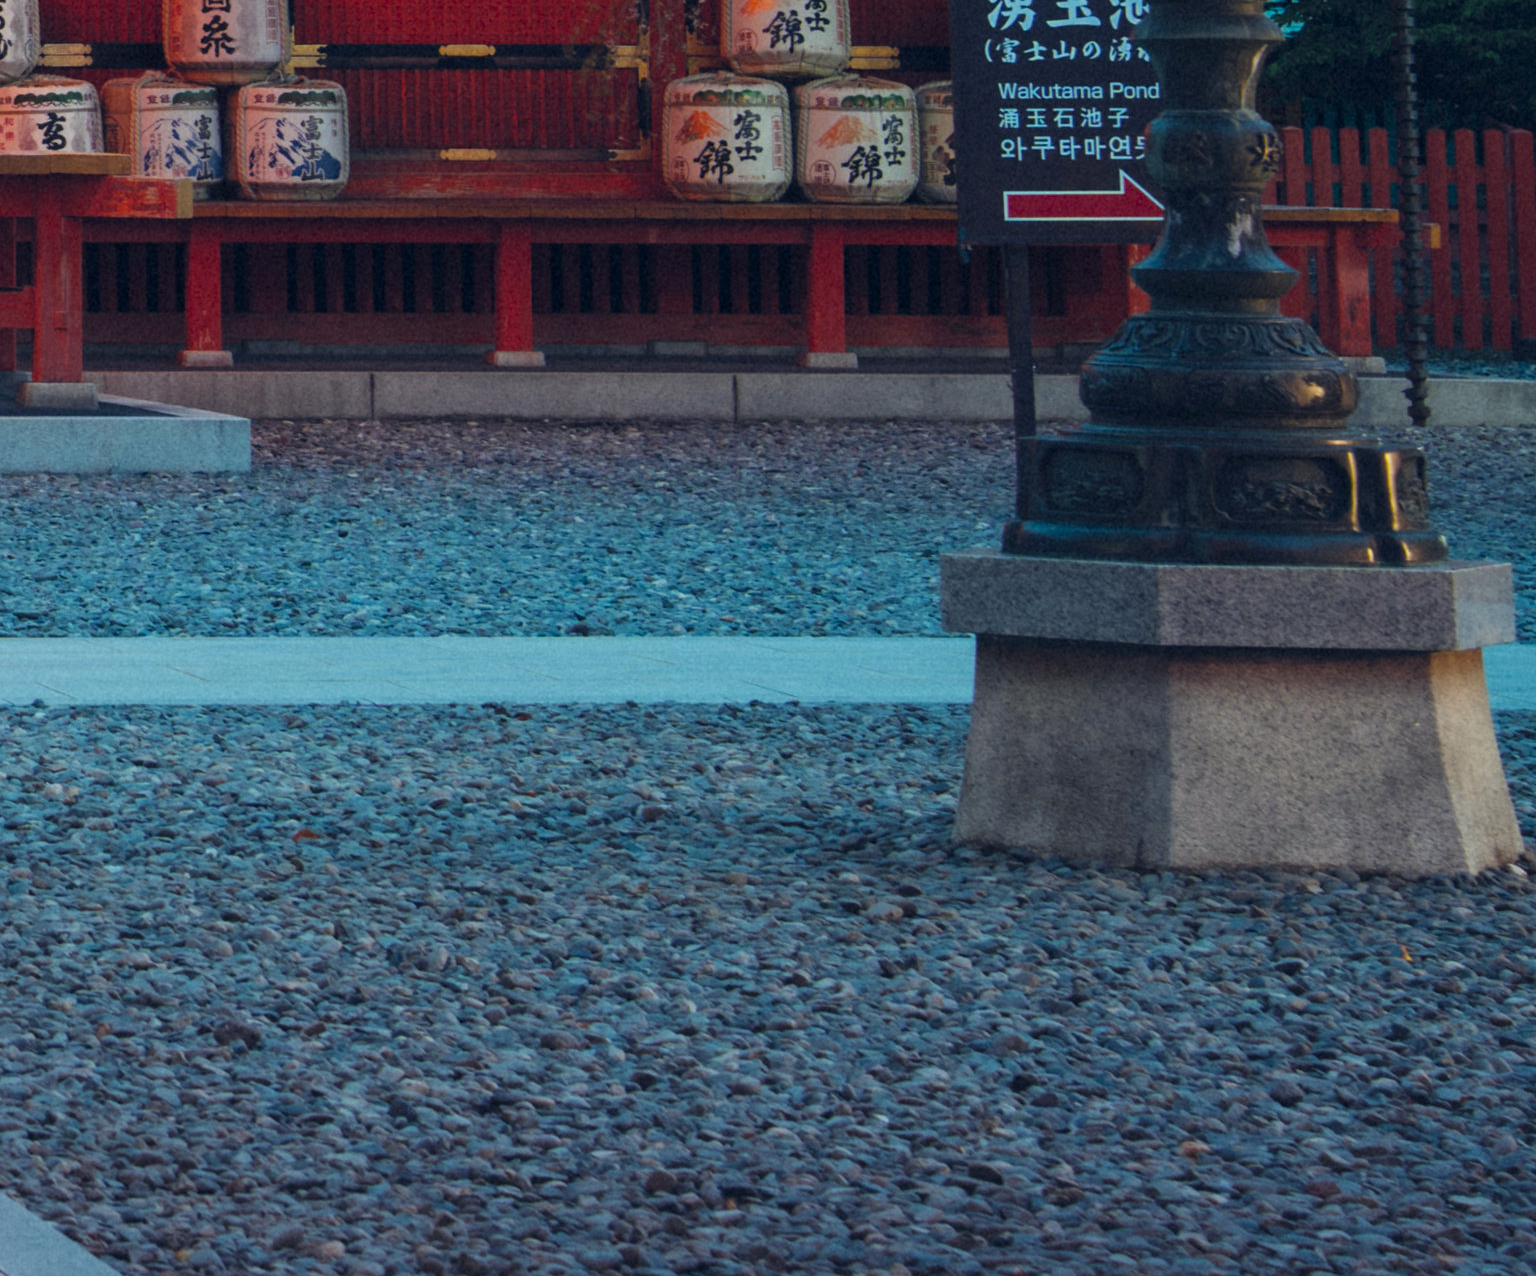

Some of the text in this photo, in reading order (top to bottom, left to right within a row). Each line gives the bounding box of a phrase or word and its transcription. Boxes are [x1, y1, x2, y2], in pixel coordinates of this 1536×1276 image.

[998, 82, 1160, 99] Wakutama Pond
[998, 107, 1129, 128] 涌玉石池子
[194, 114, 214, 180] 富士山
[301, 115, 325, 181] 富士山
